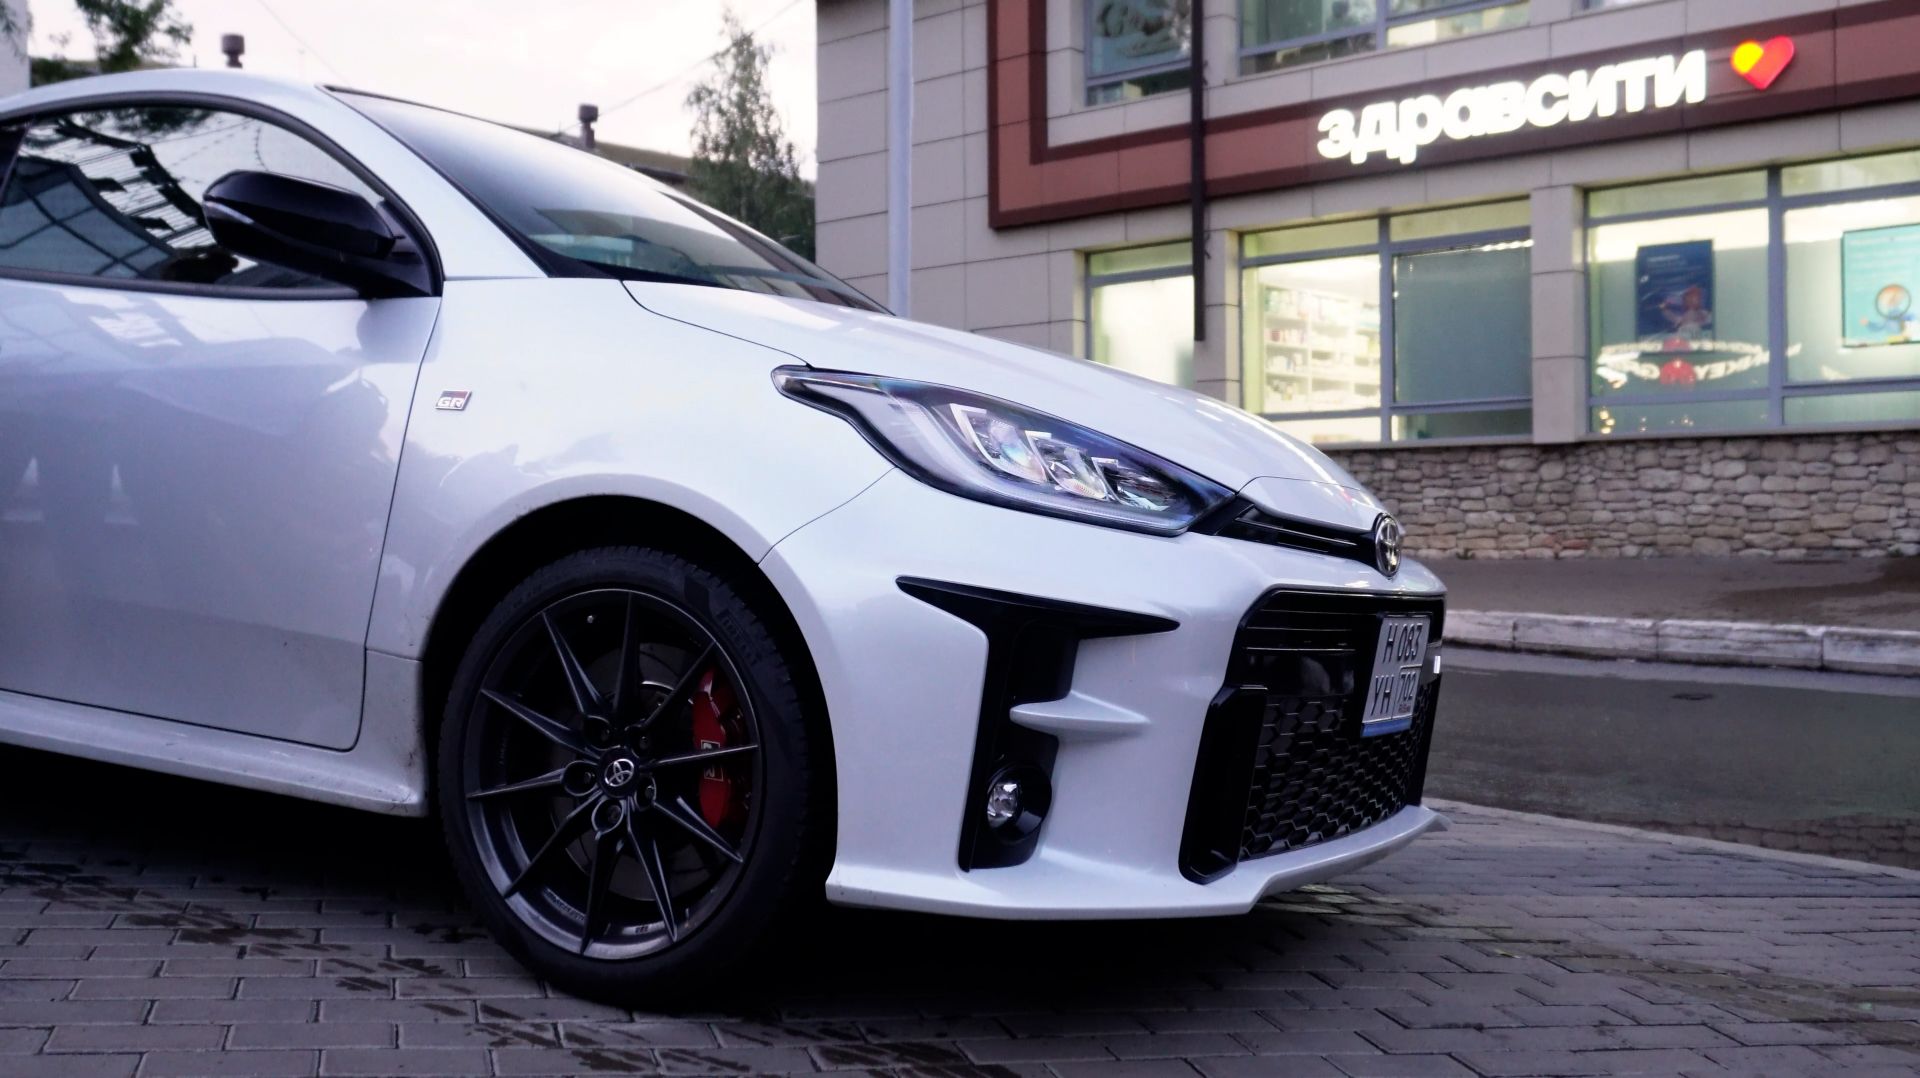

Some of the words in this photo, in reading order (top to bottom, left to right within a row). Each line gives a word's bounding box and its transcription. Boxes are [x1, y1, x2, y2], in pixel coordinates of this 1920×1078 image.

[437, 397, 465, 408] GR
[1397, 622, 1423, 663] 083
[1397, 671, 1417, 705] 702
